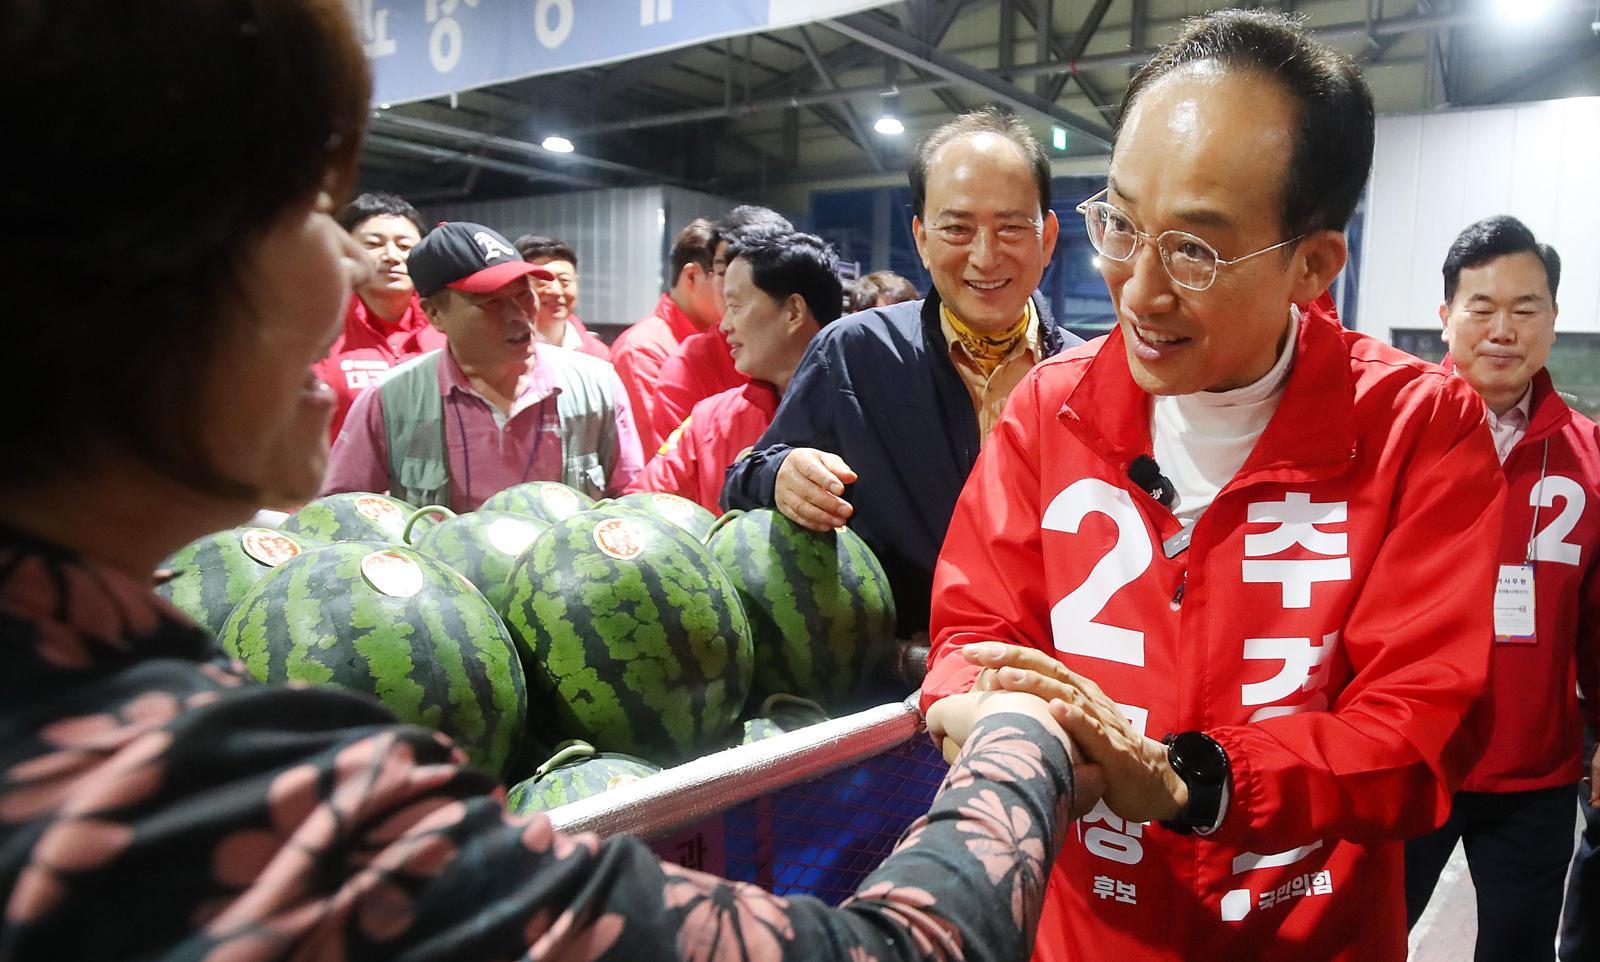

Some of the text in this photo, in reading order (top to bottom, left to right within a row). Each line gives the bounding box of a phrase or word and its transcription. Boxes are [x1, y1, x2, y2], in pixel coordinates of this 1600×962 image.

[1528, 475, 1586, 566] 2
[1040, 477, 1153, 667] 2
[1092, 875, 1137, 905] 후보
[1258, 869, 1333, 911] 국민의힘
